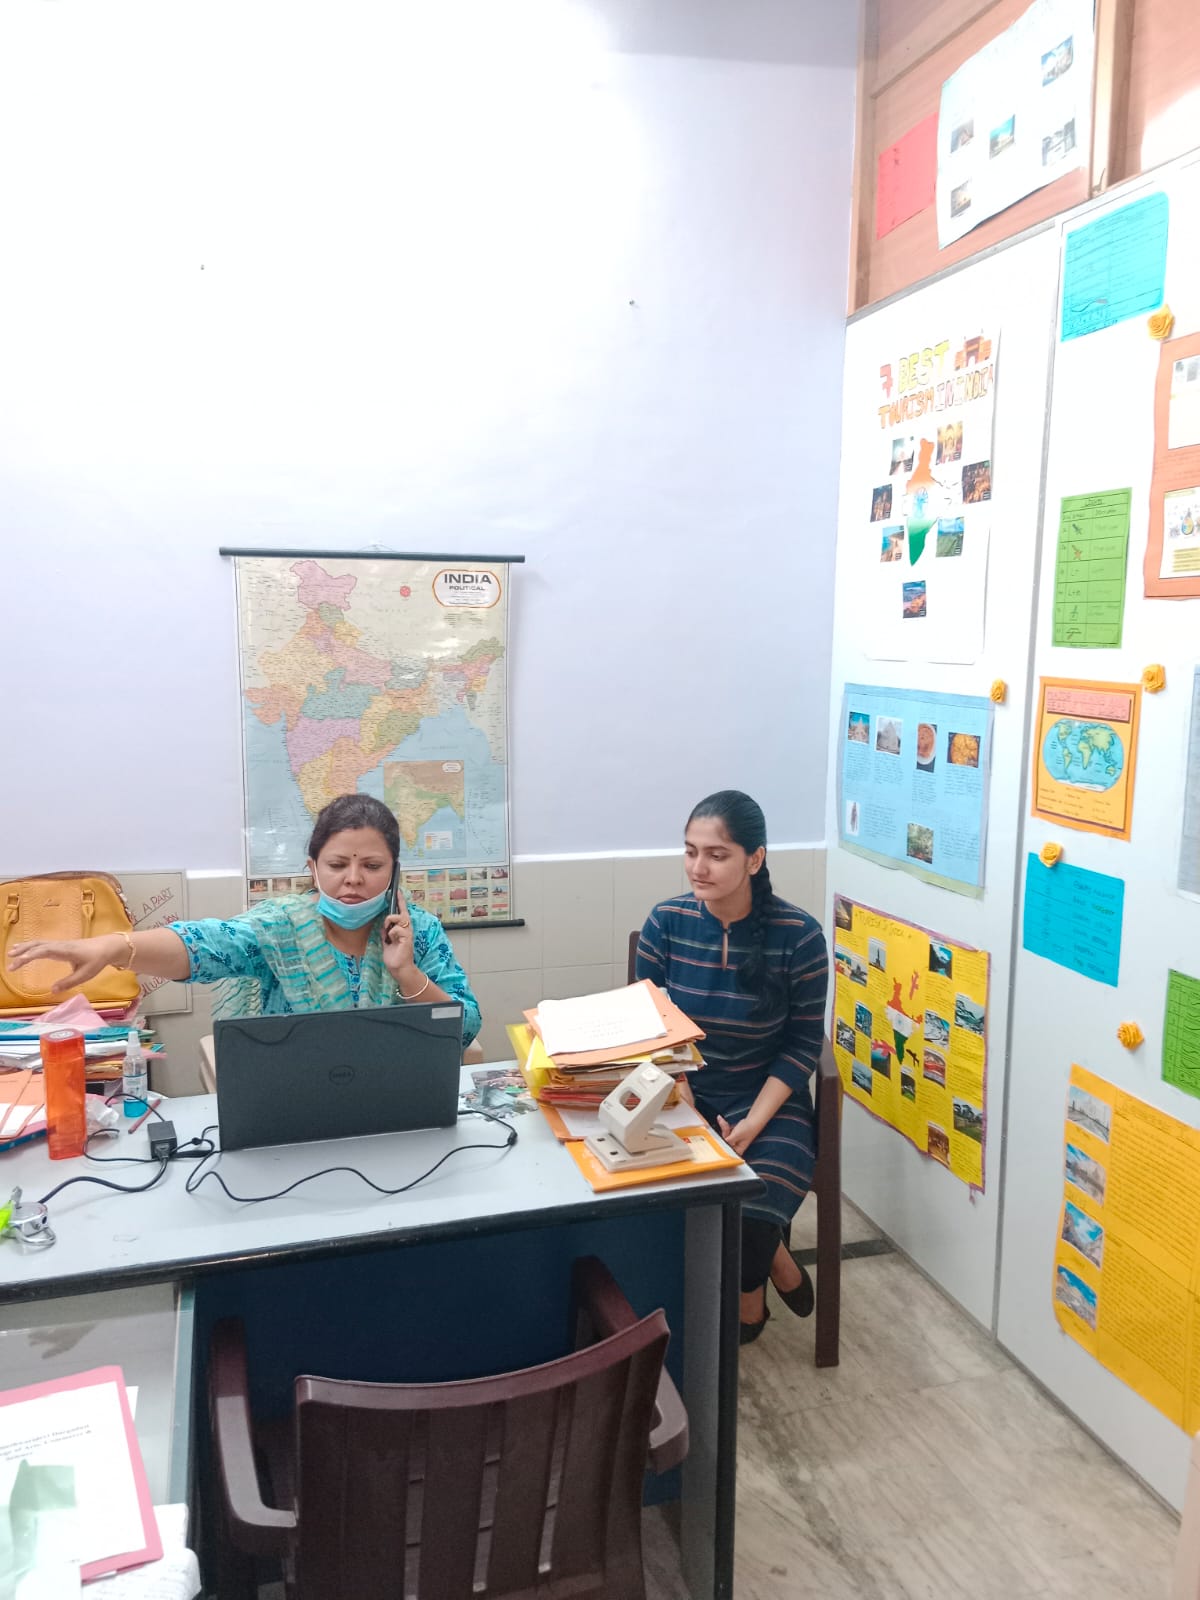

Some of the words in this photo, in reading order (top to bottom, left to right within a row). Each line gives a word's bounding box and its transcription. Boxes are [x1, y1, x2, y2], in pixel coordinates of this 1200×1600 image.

[898, 339, 950, 395] BEST
[878, 386, 935, 429] TOURISM
[444, 573, 492, 585] INDIA
[142, 902, 152, 915] A
[150, 887, 173, 908] PART
